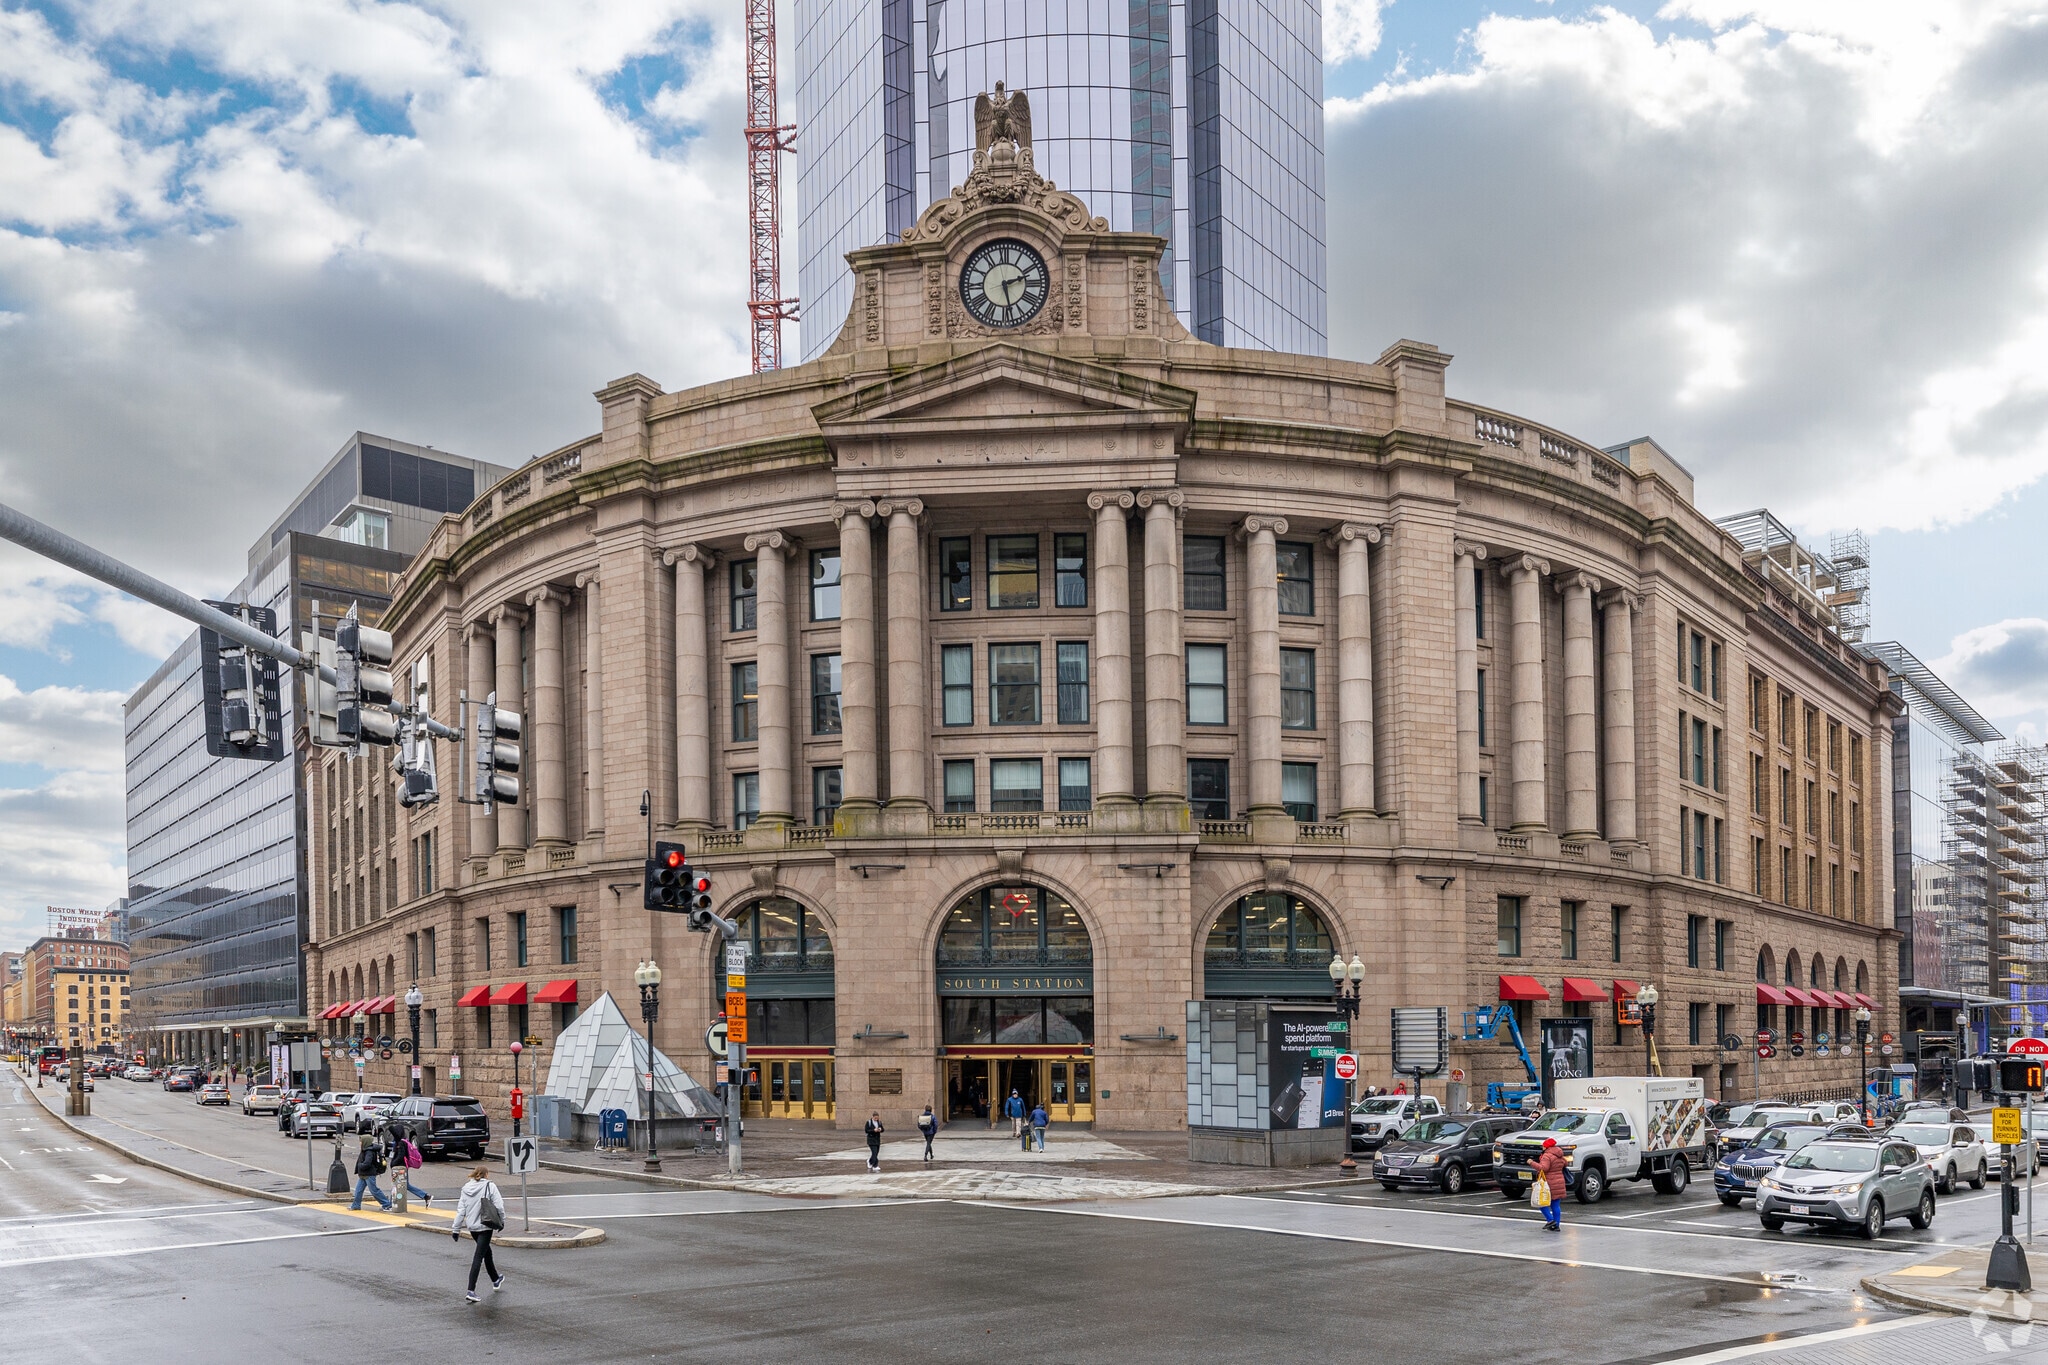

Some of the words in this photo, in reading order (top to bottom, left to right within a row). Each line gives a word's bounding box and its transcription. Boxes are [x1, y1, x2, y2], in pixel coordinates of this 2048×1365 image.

[949, 439, 1060, 457] TERMINAL
[47, 905, 76, 914] BOSTON
[944, 978, 1000, 989] SOUTH
[1012, 978, 1084, 989] STATION
[729, 997, 744, 1006] BCEC
[1283, 1023, 1296, 1032] The
[1297, 1023, 1328, 1034] AI-powere
[1285, 1034, 1305, 1044] spend
[1305, 1033, 1331, 1044] platform
[402, 1043, 409, 1051] 2
[1553, 1069, 1582, 1078] LONG
[1591, 1086, 1607, 1094] bindi
